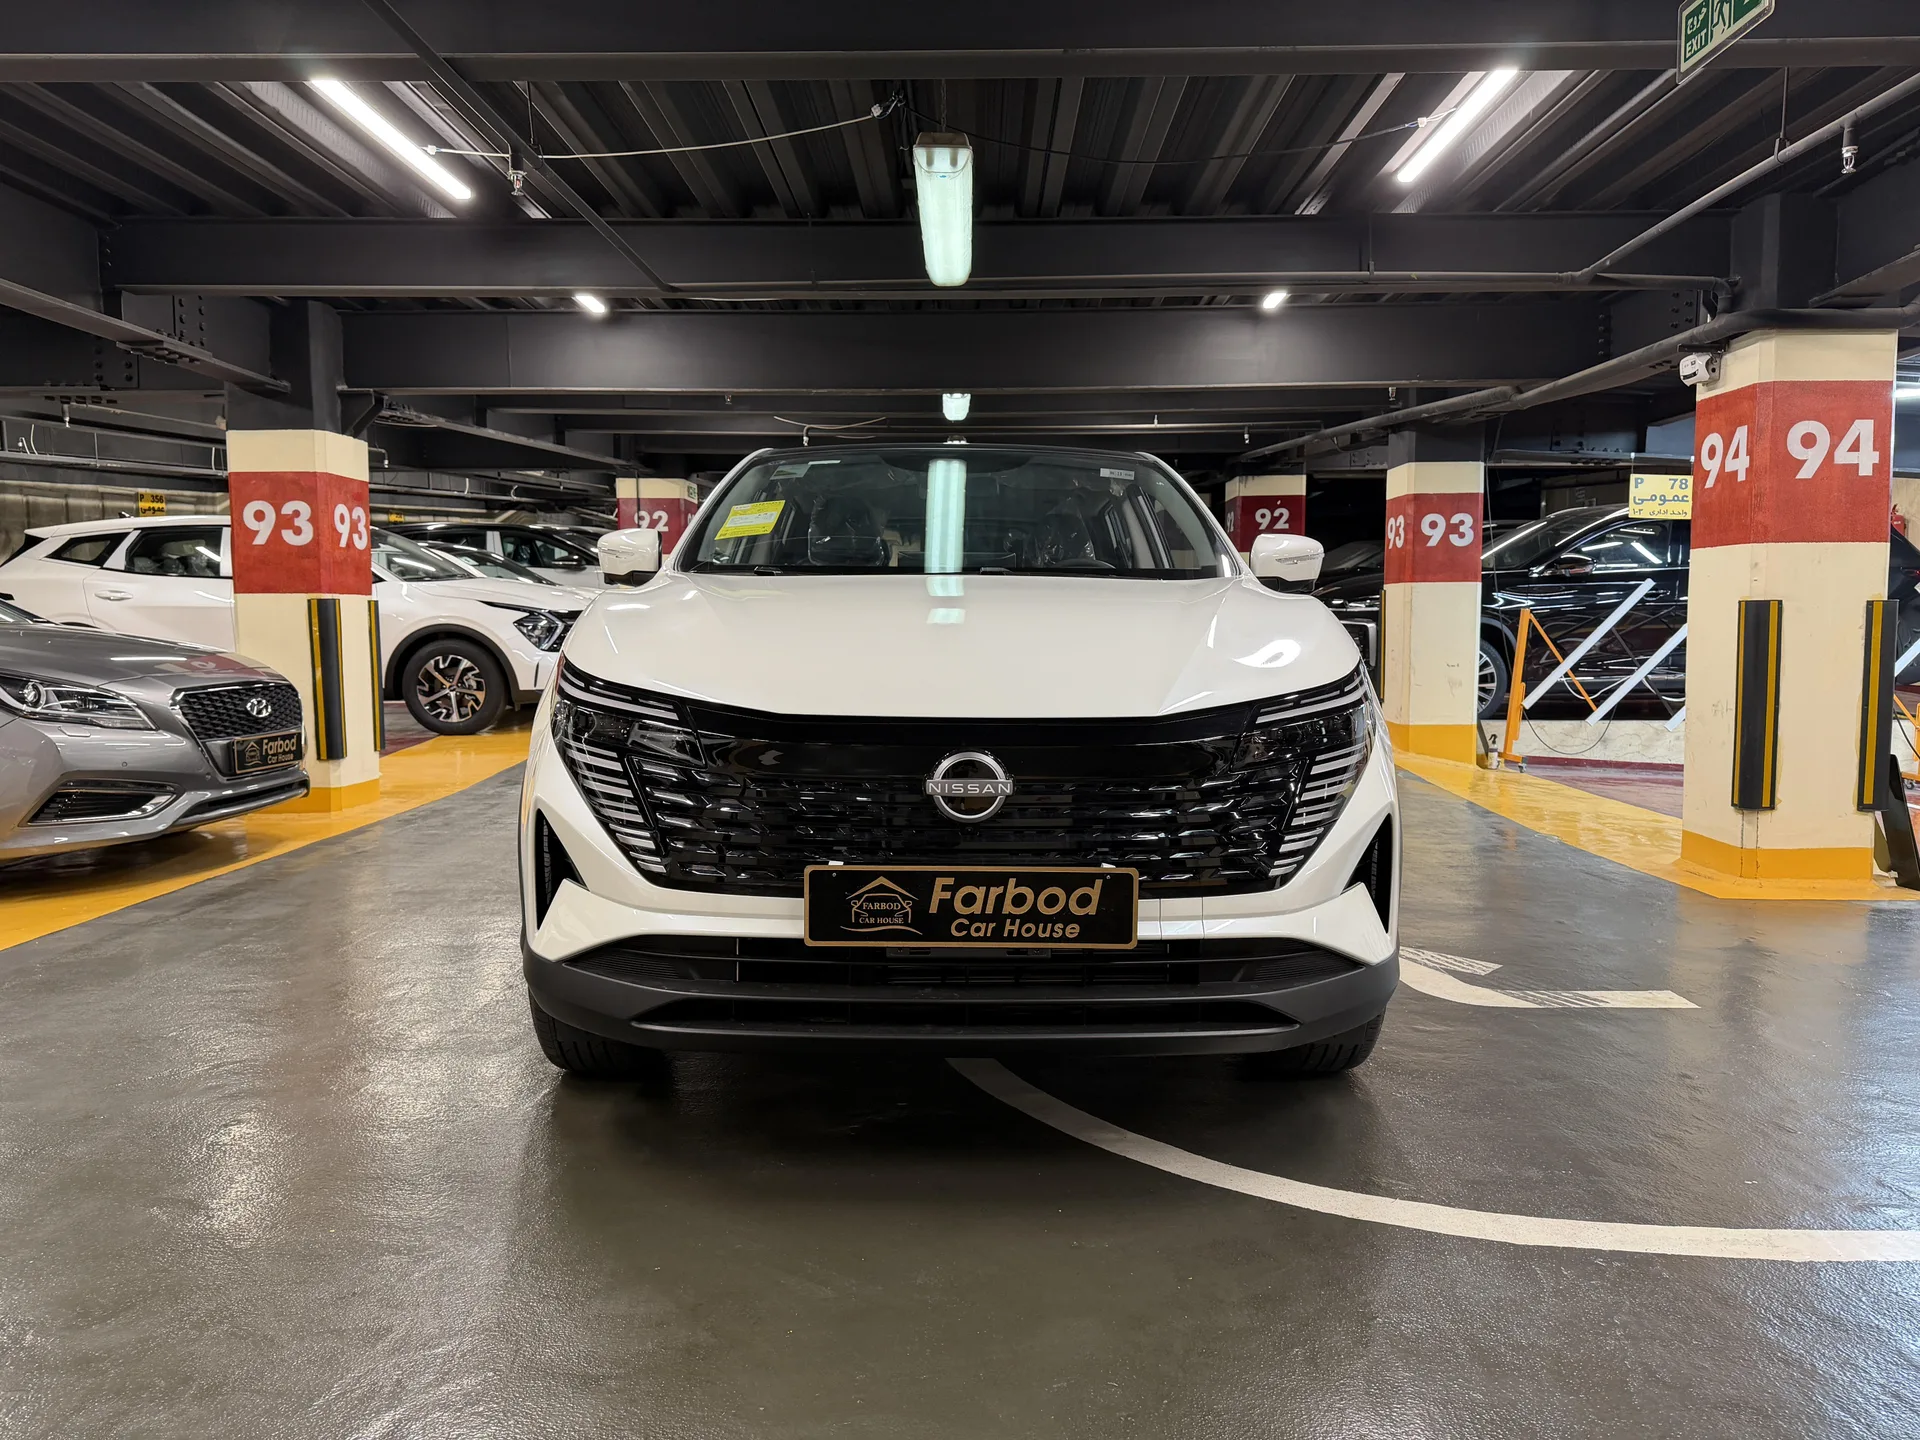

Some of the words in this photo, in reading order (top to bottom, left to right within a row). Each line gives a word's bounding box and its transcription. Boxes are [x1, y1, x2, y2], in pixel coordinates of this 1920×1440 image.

[1685, 28, 1707, 58] EXIT
[1701, 425, 1750, 489] 94
[1787, 419, 1880, 479] 94
[1634, 477, 1645, 489] P
[1668, 478, 1689, 490] 78
[139, 493, 145, 502] P
[1633, 494, 1690, 506] عمومی
[634, 510, 669, 532] 92
[1255, 507, 1290, 530] 92
[1649, 508, 1669, 516] اداری
[1669, 509, 1688, 517] واحد
[243, 500, 314, 546] 93
[334, 503, 368, 550] 93
[1387, 514, 1405, 550] 93
[1421, 512, 1475, 547] 93
[262, 735, 297, 755] Farbod
[267, 755, 278, 764] Car
[928, 783, 1011, 794] NISSAN
[862, 902, 901, 910] FARBOD
[928, 877, 1103, 916] Farbod
[950, 918, 997, 937] Car
[1003, 918, 1081, 938] House
